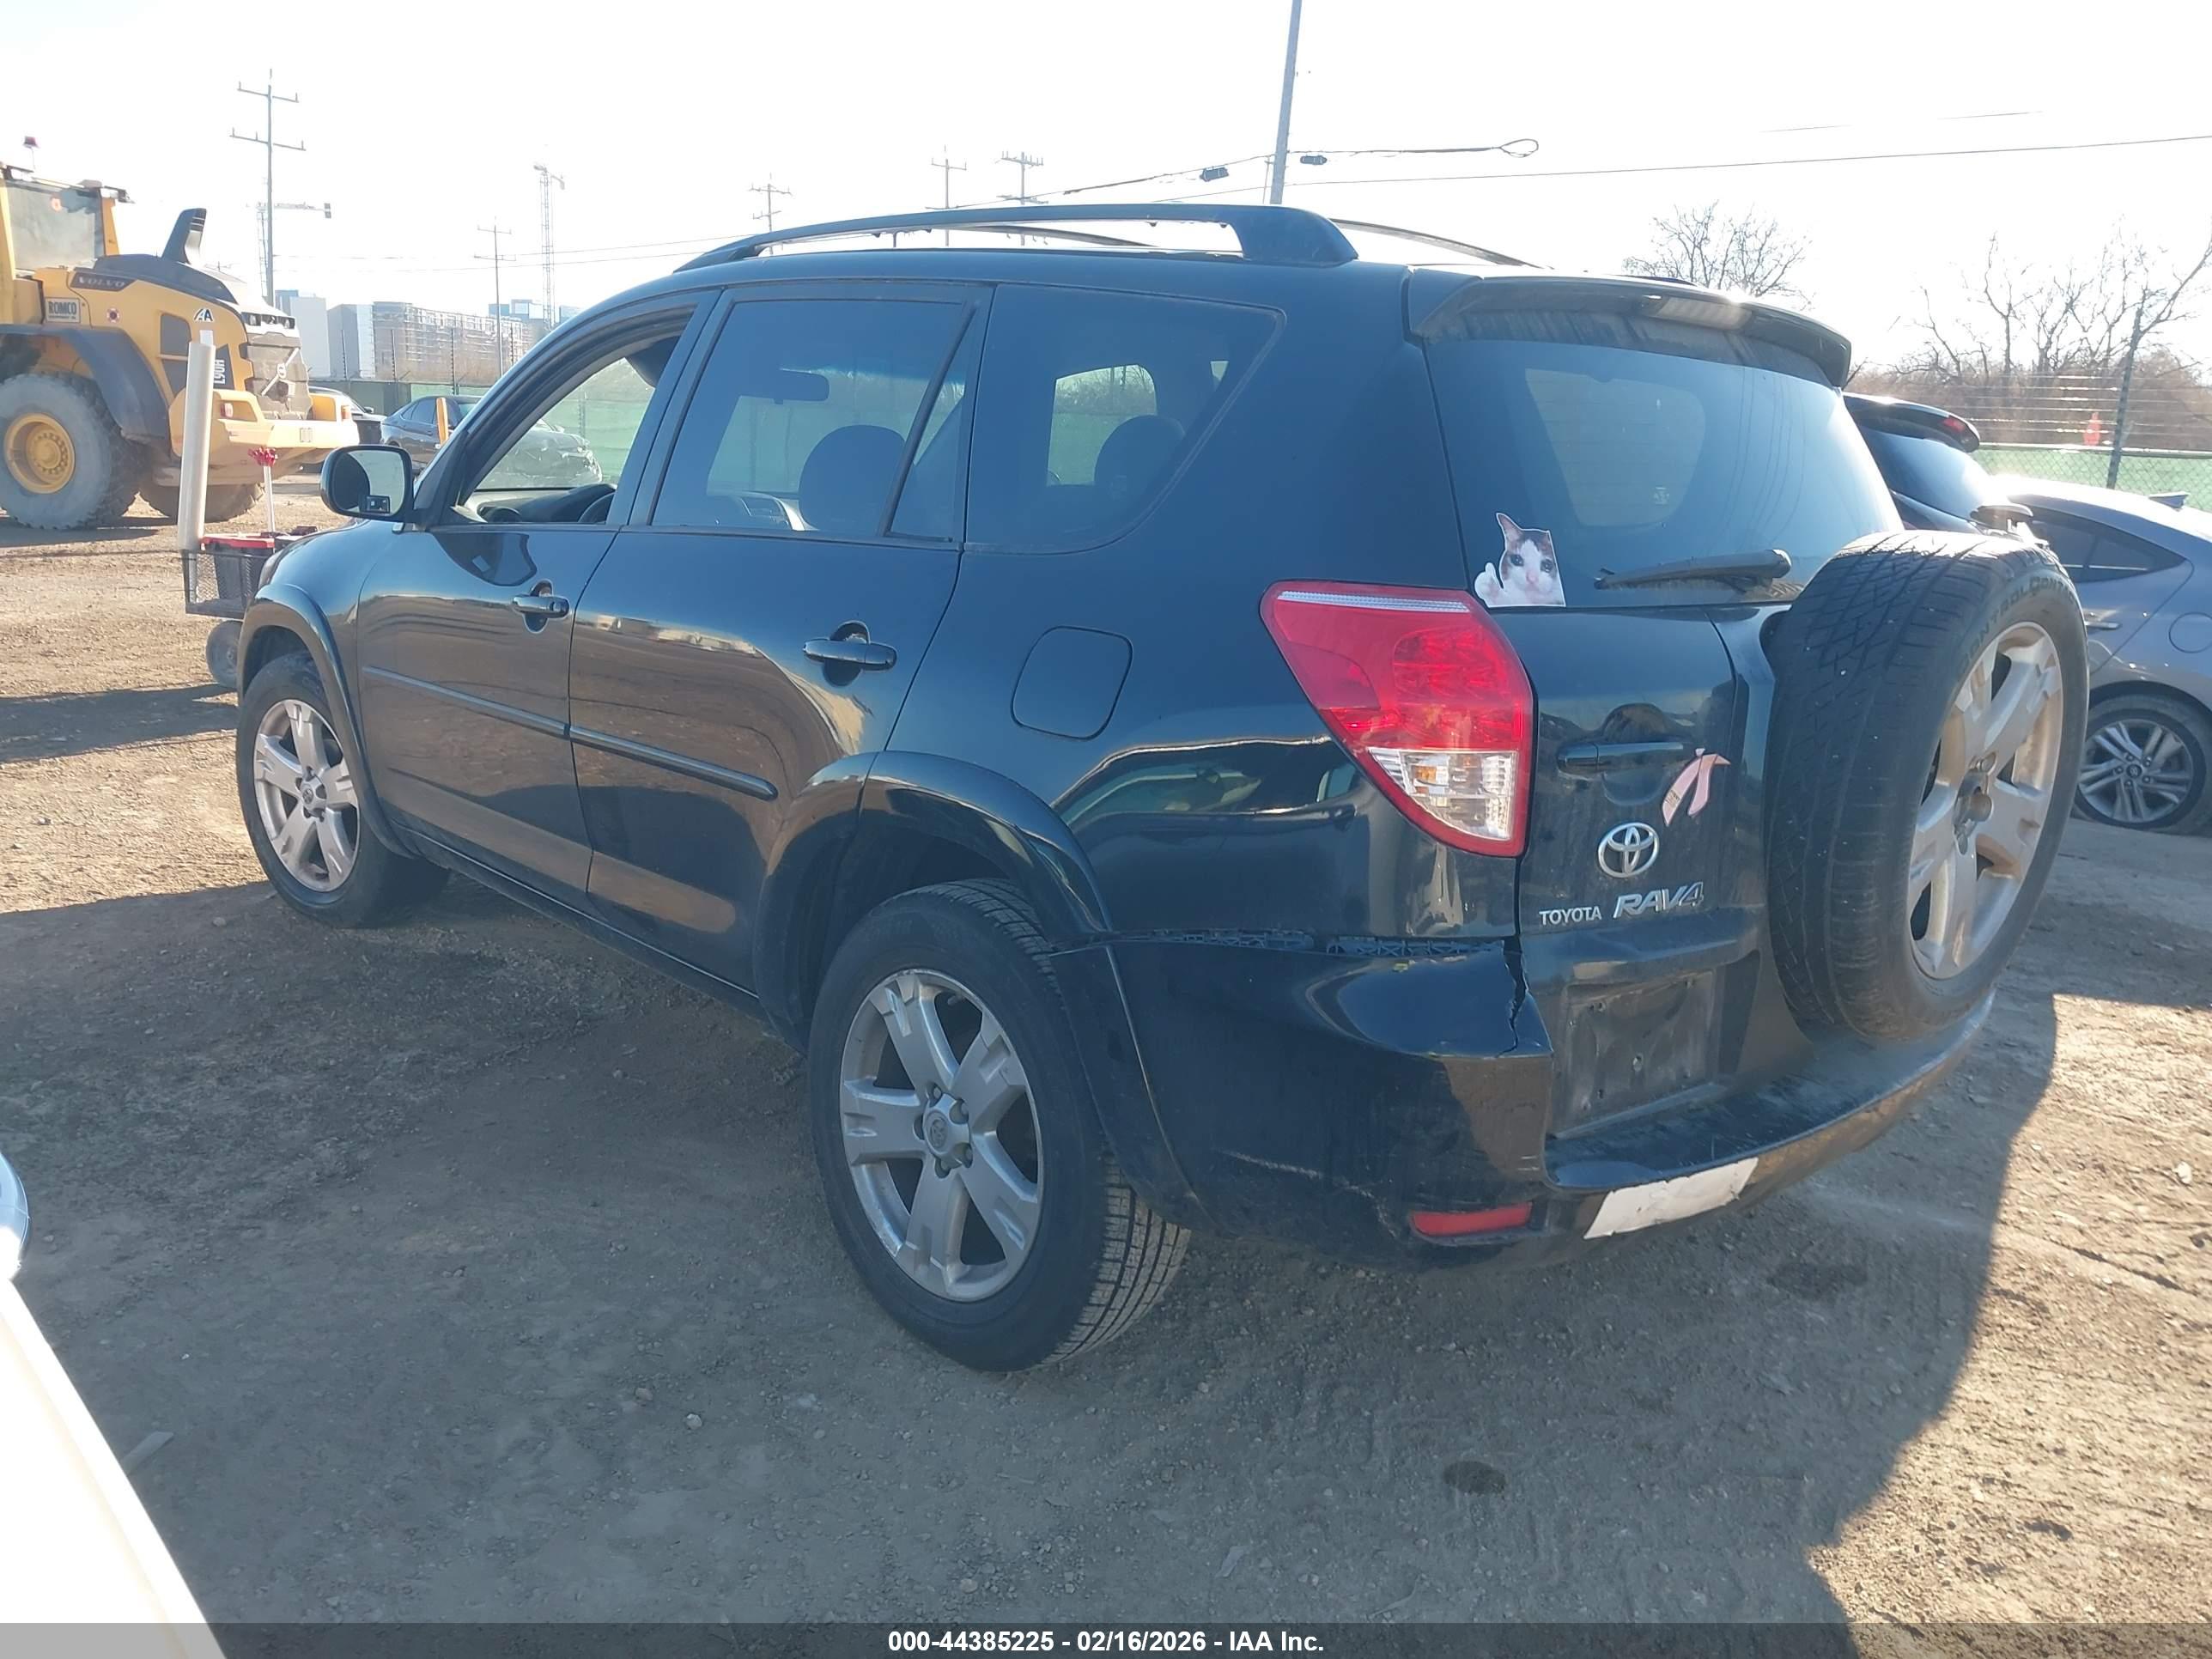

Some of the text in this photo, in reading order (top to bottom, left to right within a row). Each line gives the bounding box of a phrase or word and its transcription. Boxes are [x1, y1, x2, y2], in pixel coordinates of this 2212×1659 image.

[48, 301, 77, 314] ROMCO
[1539, 881, 1705, 926] TOYOTA RAV4
